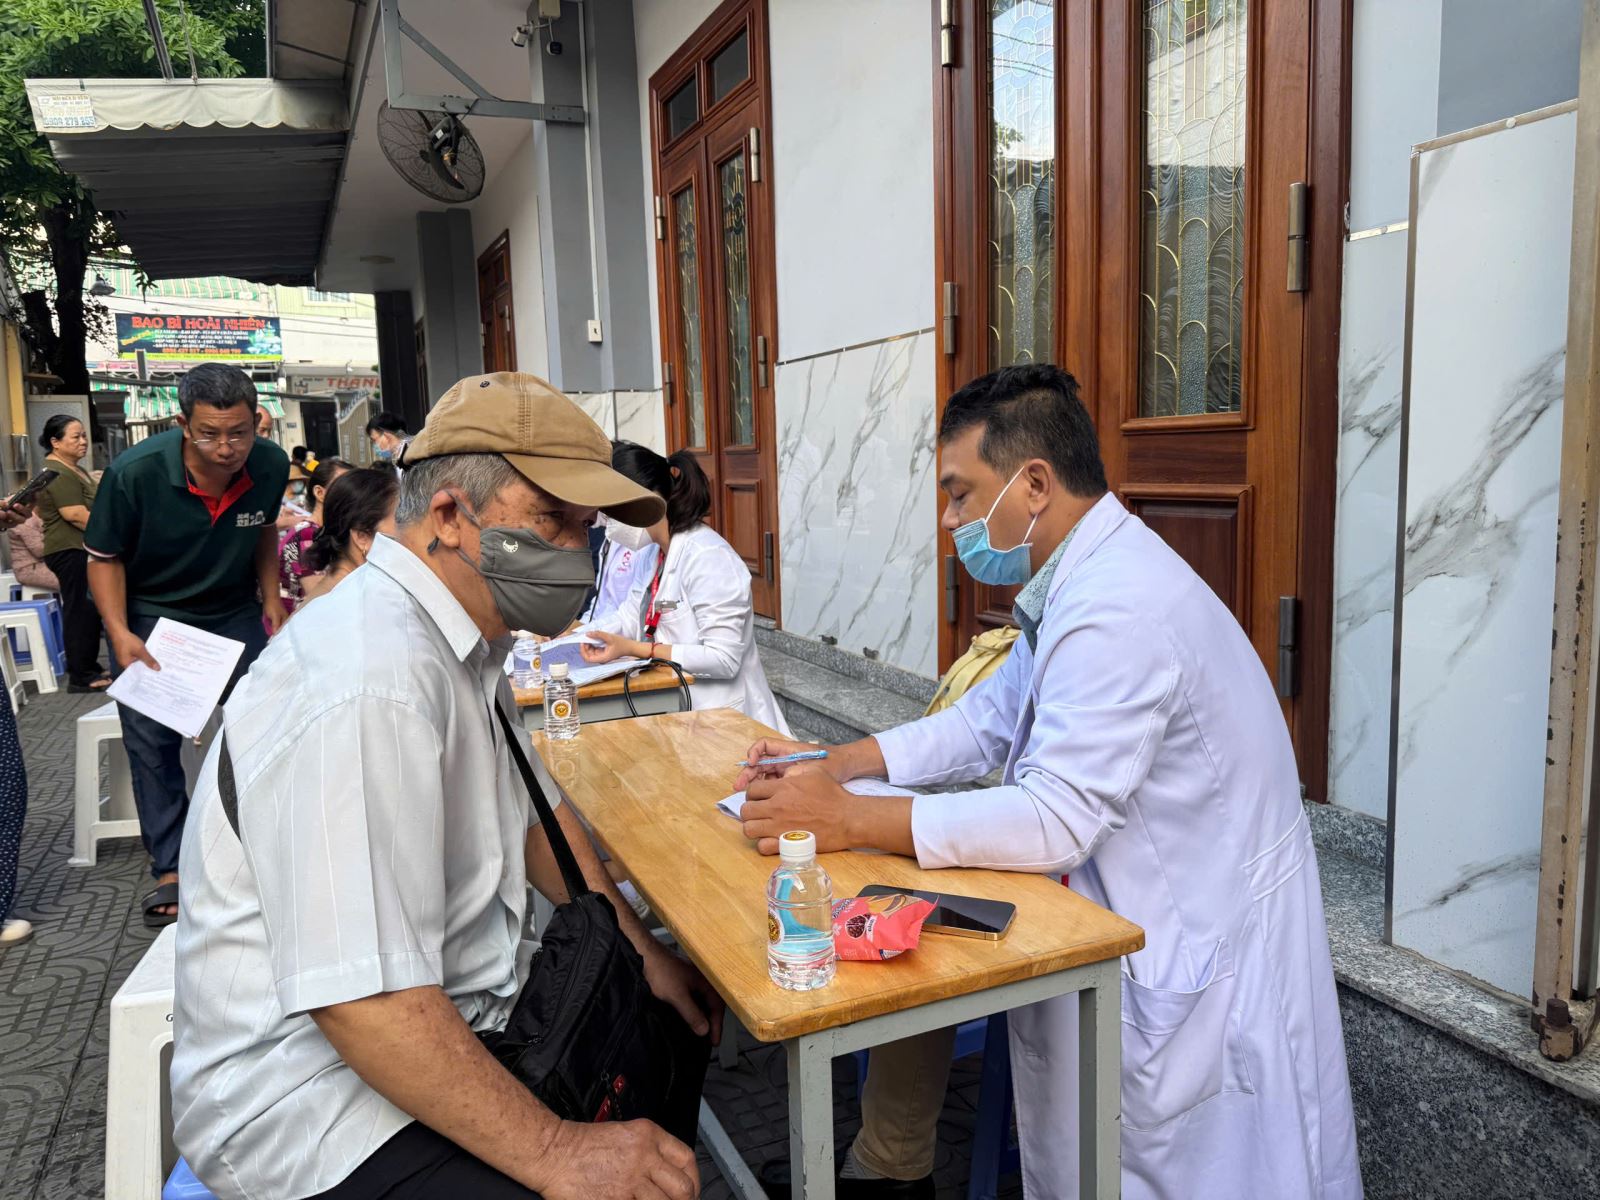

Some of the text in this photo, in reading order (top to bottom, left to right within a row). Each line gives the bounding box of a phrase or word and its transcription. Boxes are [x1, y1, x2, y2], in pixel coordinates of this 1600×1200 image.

[131, 316, 164, 329] BAO
[167, 315, 182, 329] BÌ
[185, 315, 221, 330] HOÀI
